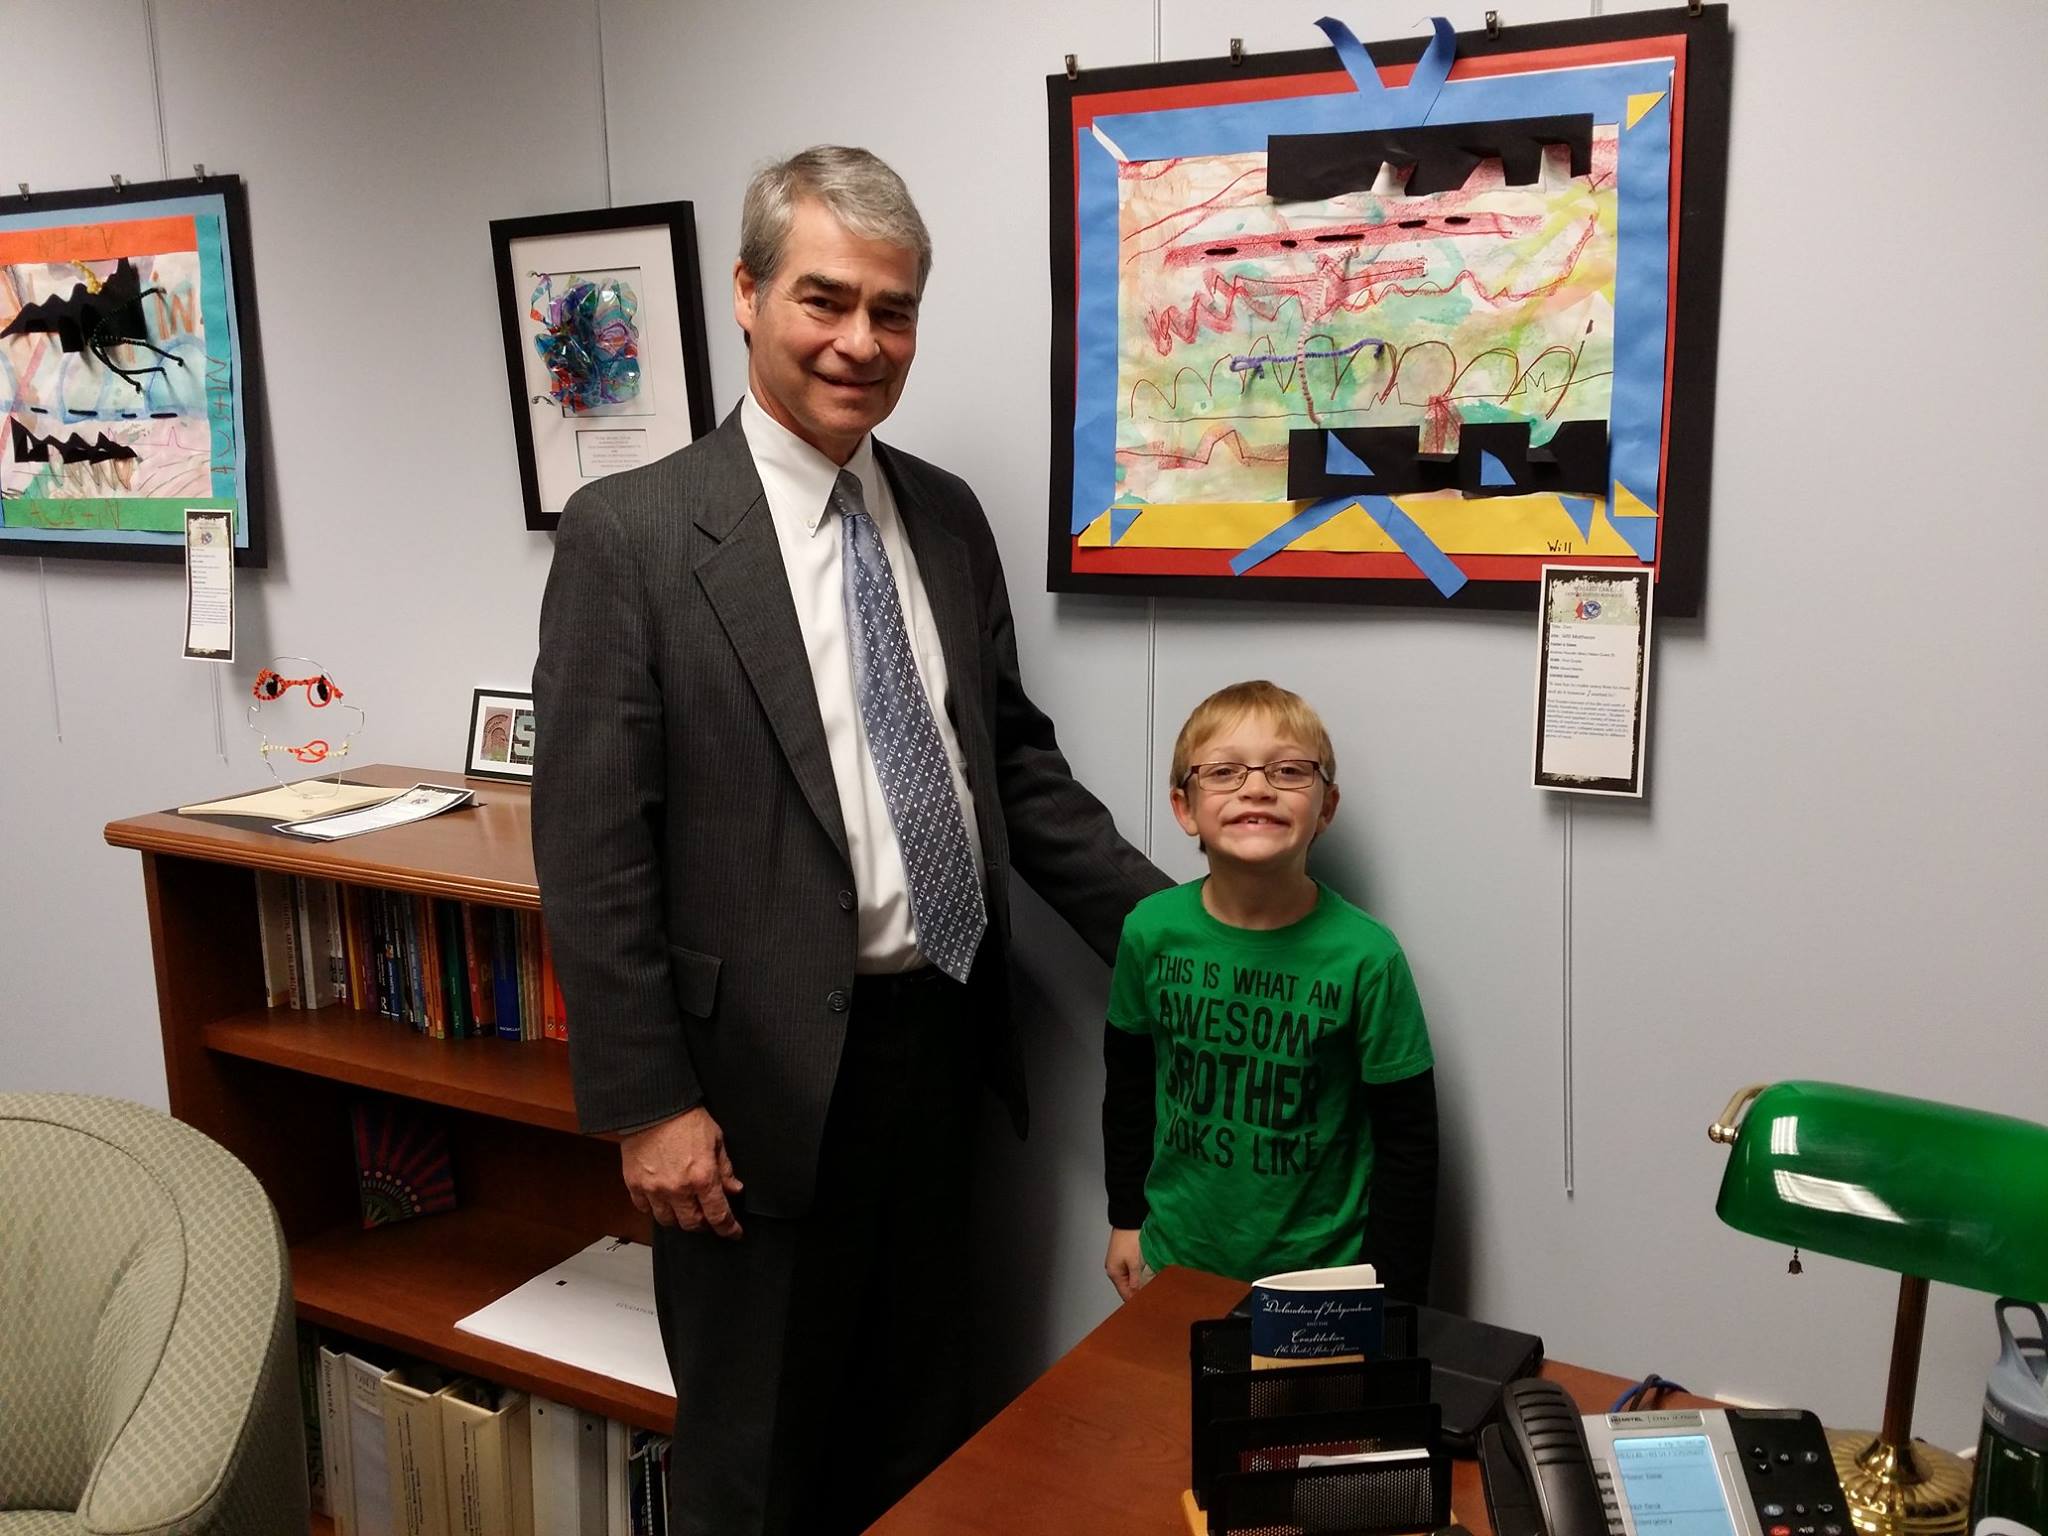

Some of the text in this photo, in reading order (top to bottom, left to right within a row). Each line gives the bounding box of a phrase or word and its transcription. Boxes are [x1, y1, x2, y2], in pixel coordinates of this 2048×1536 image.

[1547, 539, 1572, 554] Will
[1154, 954, 1342, 1011] THIS IS WHAT AN
[1253, 1129, 1321, 1176] LIKE
[1262, 1299, 1313, 1314] Declaration
[1313, 1300, 1328, 1321] of
[1291, 1329, 1345, 1343] Constitution
